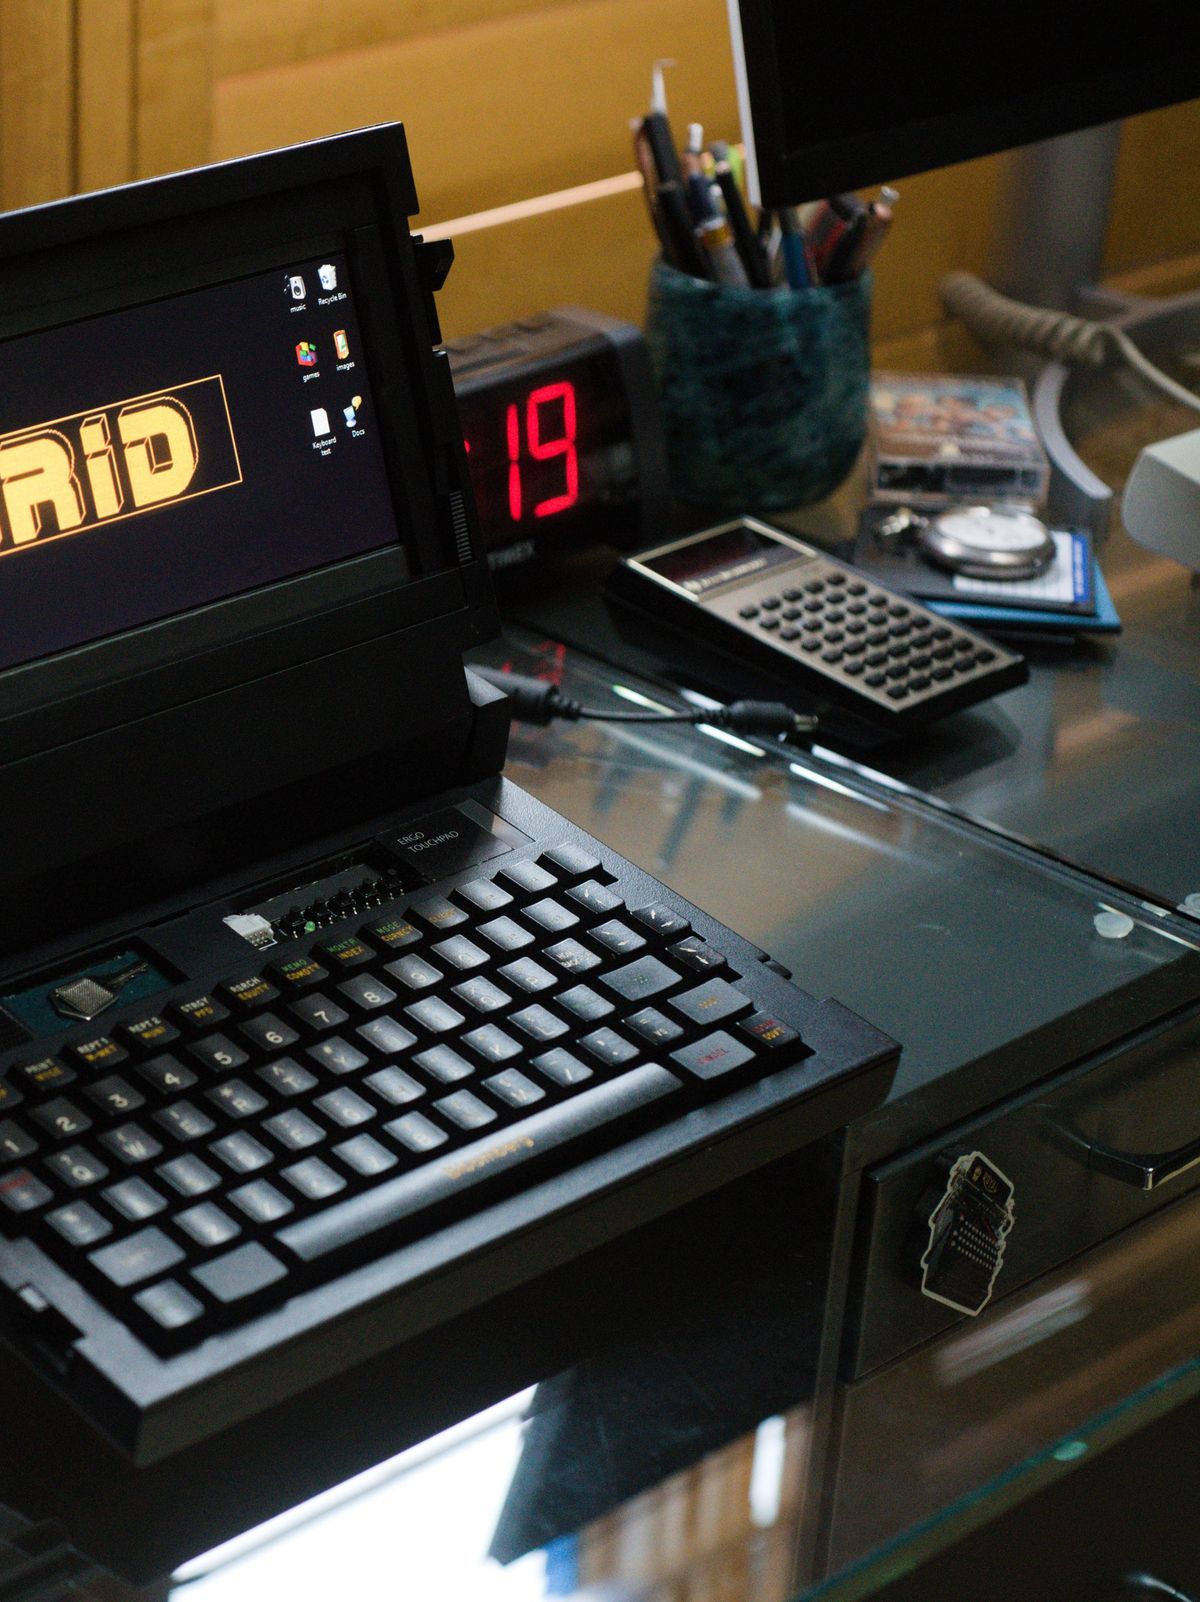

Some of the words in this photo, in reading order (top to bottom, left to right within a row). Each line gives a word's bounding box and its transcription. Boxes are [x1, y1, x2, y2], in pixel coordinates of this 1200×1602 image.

[318, 293, 338, 306] Recycle
[337, 291, 348, 301] Bin
[290, 303, 307, 313] music
[336, 361, 355, 372] images
[302, 371, 320, 383] games
[351, 428, 366, 438] Docs
[312, 436, 337, 450] Keyboard
[320, 448, 332, 457] test
[397, 831, 425, 846] ERGO
[408, 830, 459, 853] TOUCHPAD
[410, 972, 427, 983] 9
[363, 991, 381, 1003] 8
[313, 1010, 330, 1024] 7
[265, 1031, 284, 1044] 6
[213, 1051, 233, 1065] 5
[164, 1071, 181, 1086] 4
[108, 1093, 128, 1109] 3
[56, 1116, 77, 1132] 2
[4, 1139, 20, 1153] 1
